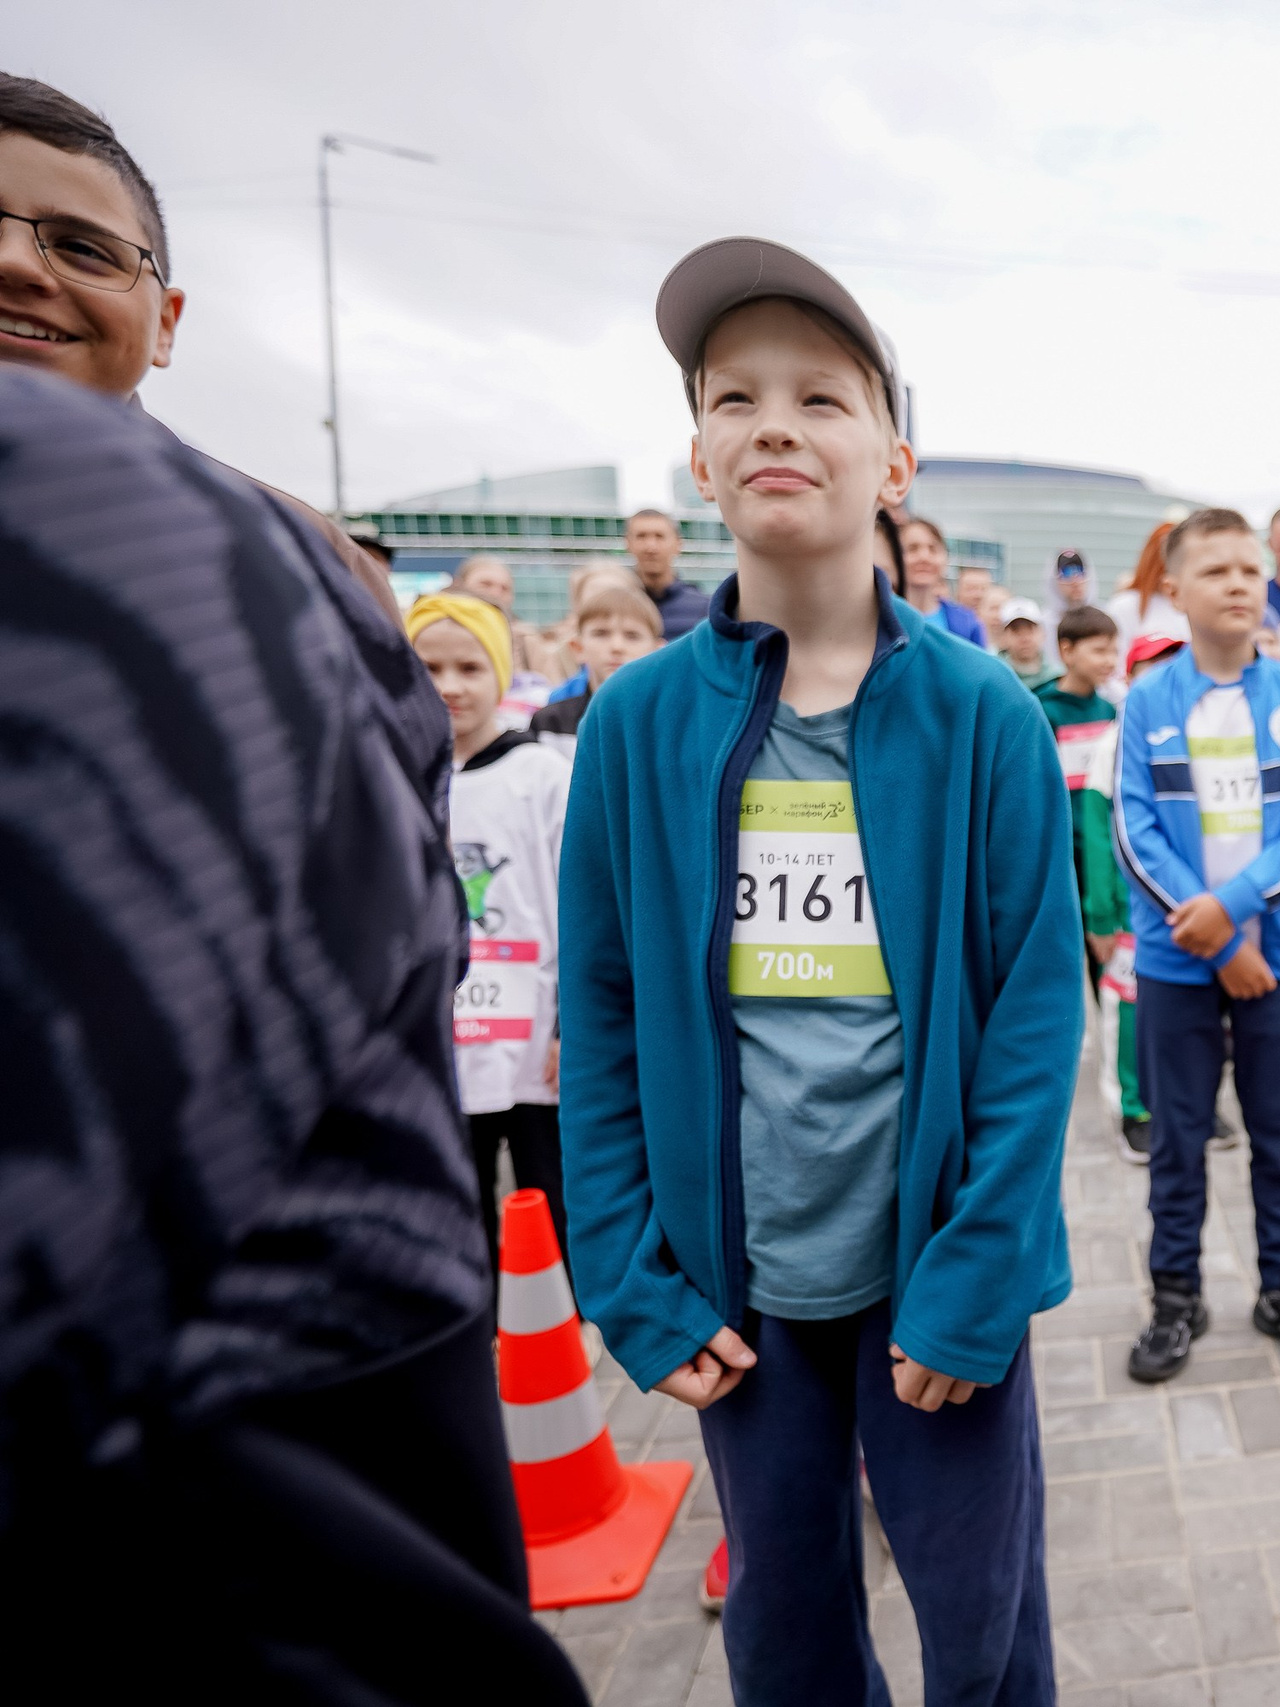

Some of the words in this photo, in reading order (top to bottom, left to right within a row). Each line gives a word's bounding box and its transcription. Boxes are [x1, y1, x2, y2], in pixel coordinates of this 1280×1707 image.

[740, 804, 764, 815] БЕР
[759, 853, 800, 866] 10-14
[804, 854, 836, 866] ЛЕТ
[734, 873, 866, 923] 3161
